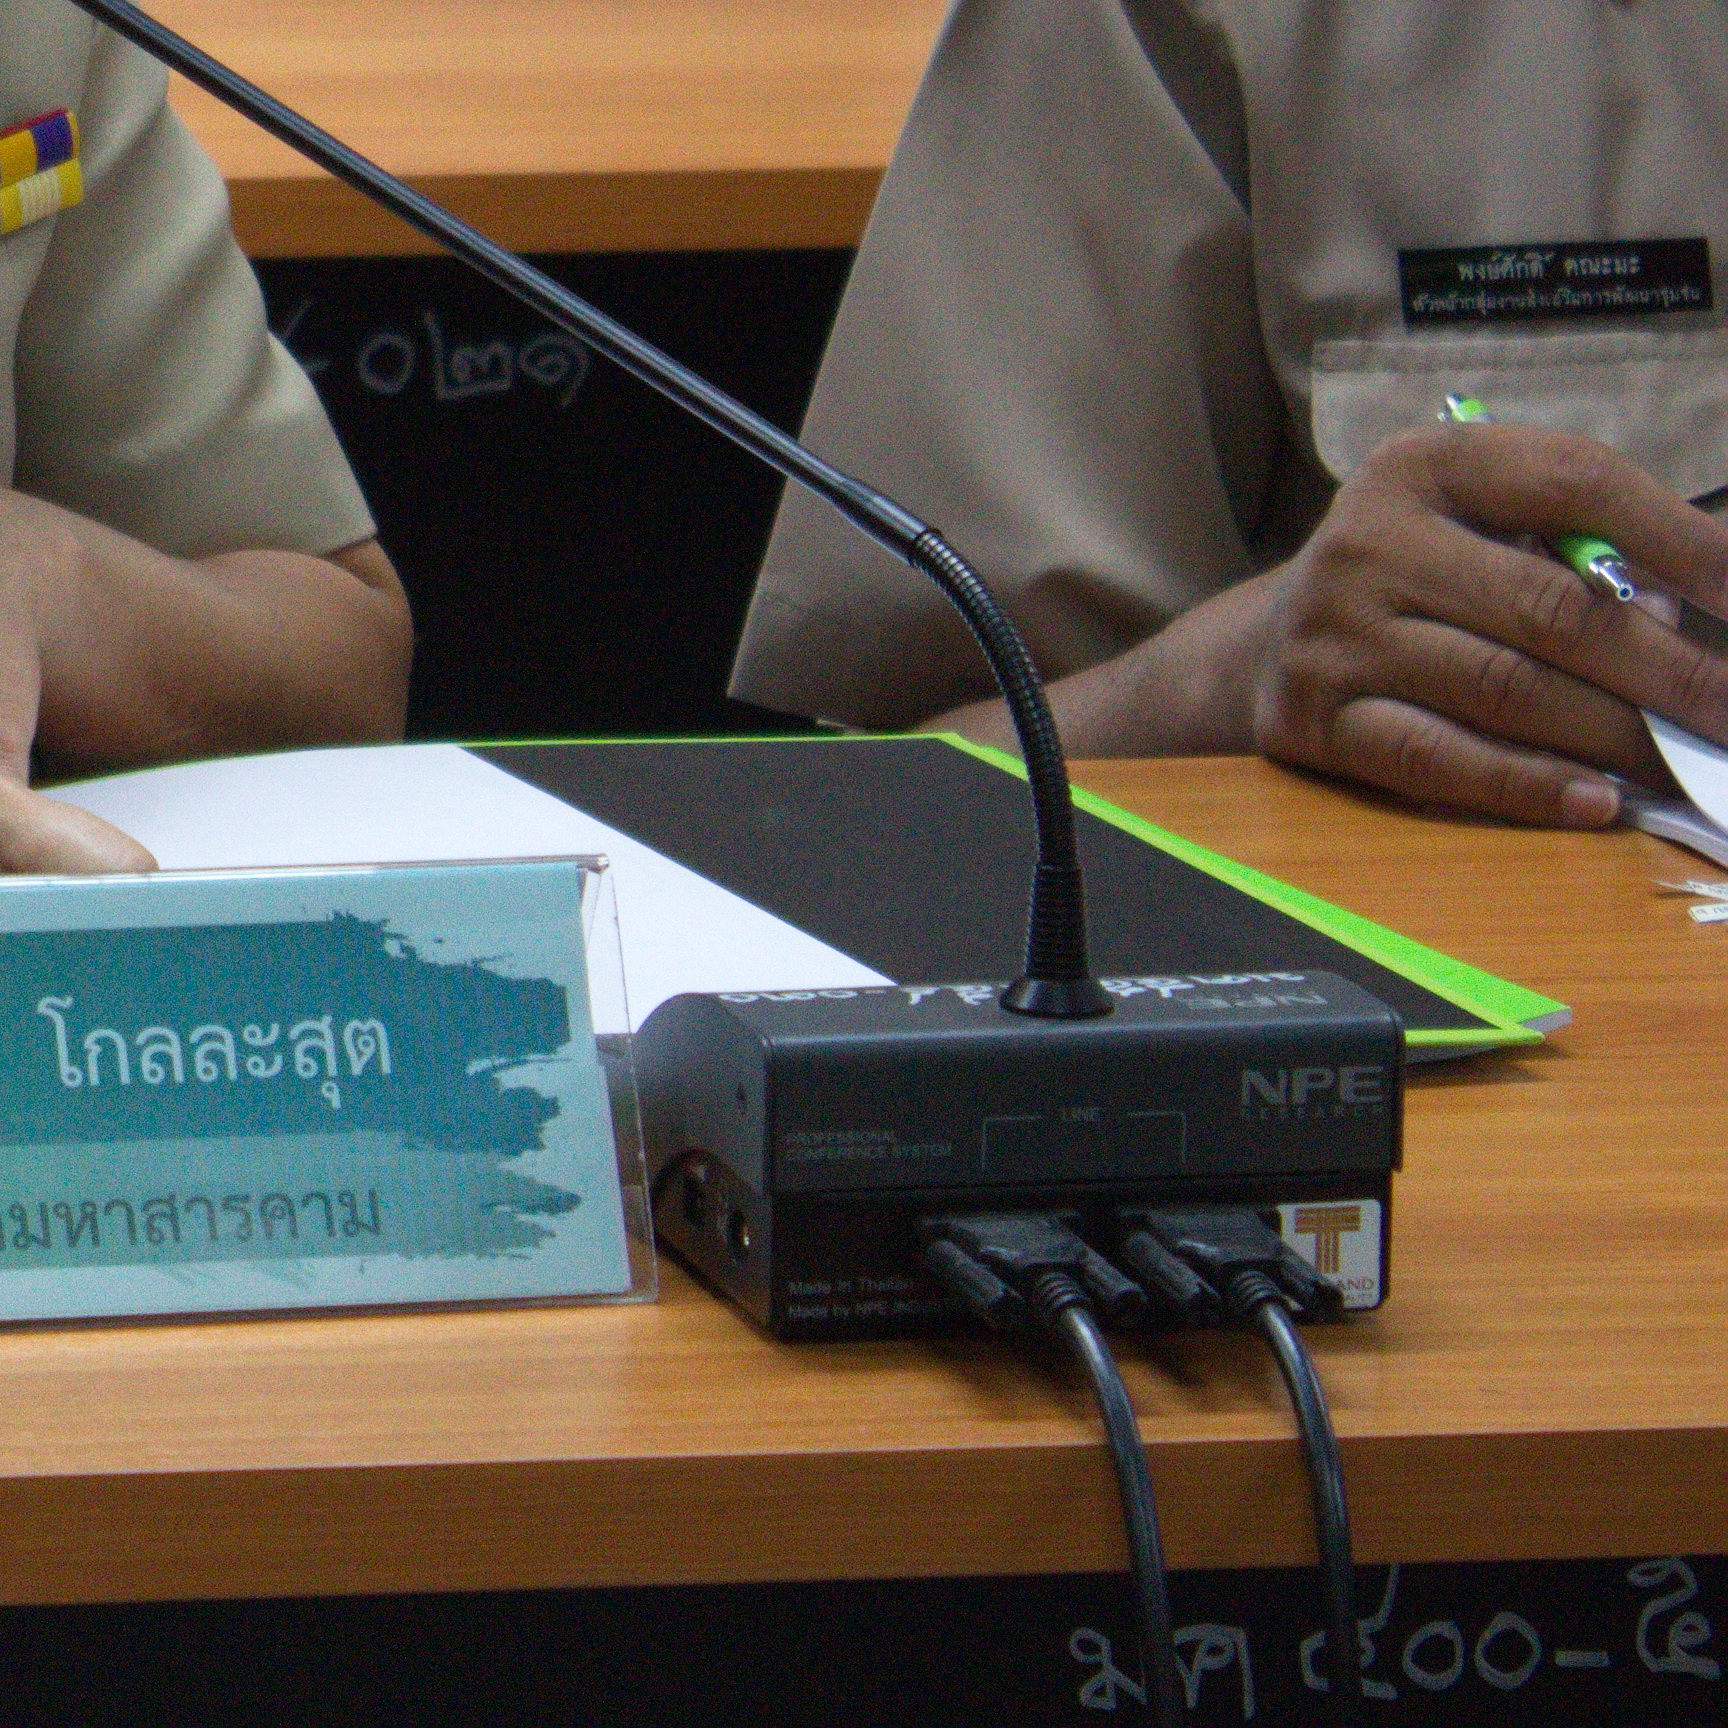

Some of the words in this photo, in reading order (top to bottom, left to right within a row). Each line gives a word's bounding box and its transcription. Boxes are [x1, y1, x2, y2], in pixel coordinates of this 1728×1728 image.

[37, 995, 392, 1110] โกลละสุต
[1239, 1065, 1384, 1106] NPE
[1060, 1106, 1102, 1122] LINE
